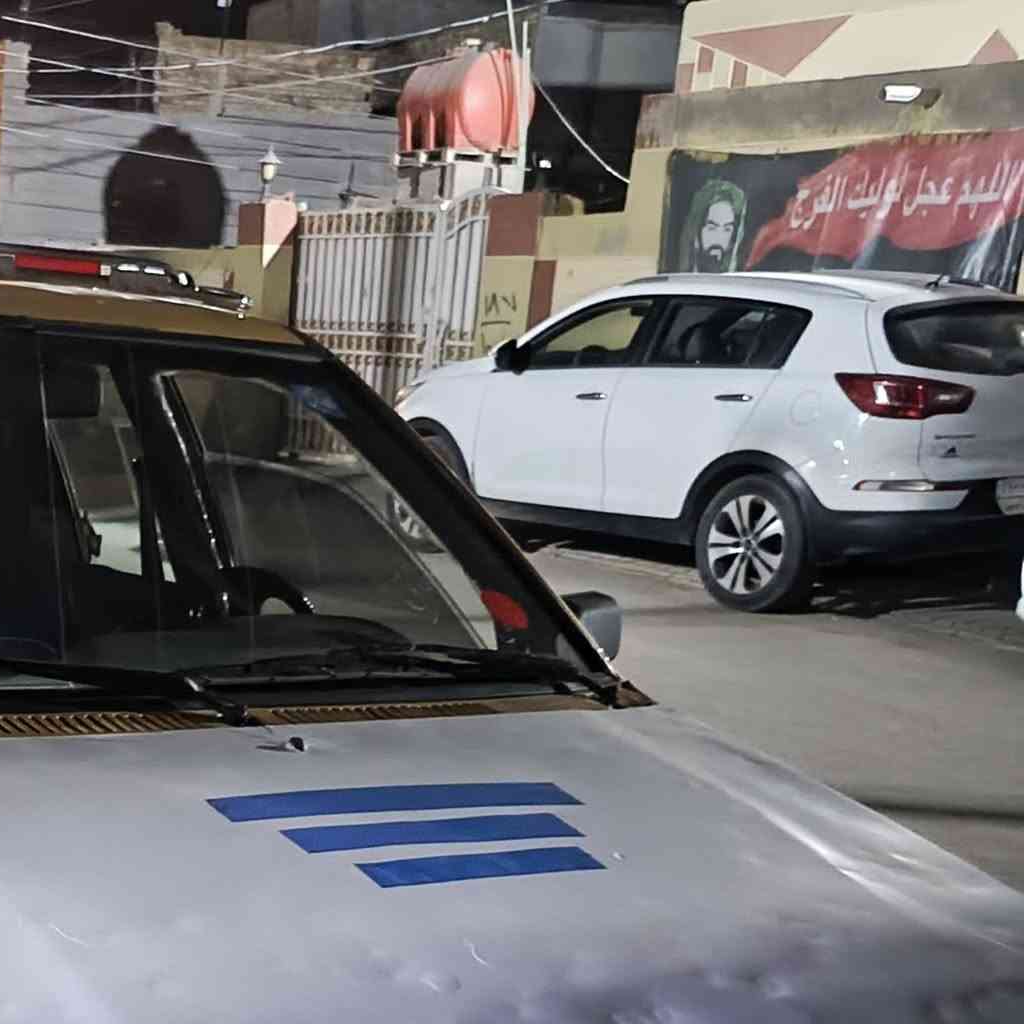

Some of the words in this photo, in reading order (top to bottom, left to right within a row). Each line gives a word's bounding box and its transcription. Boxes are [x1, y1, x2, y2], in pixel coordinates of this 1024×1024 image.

[789, 174, 848, 230] الفرج
[848, 161, 910, 219] لوليك
[902, 164, 954, 216] عجل
[953, 160, 1017, 221] اللهم
